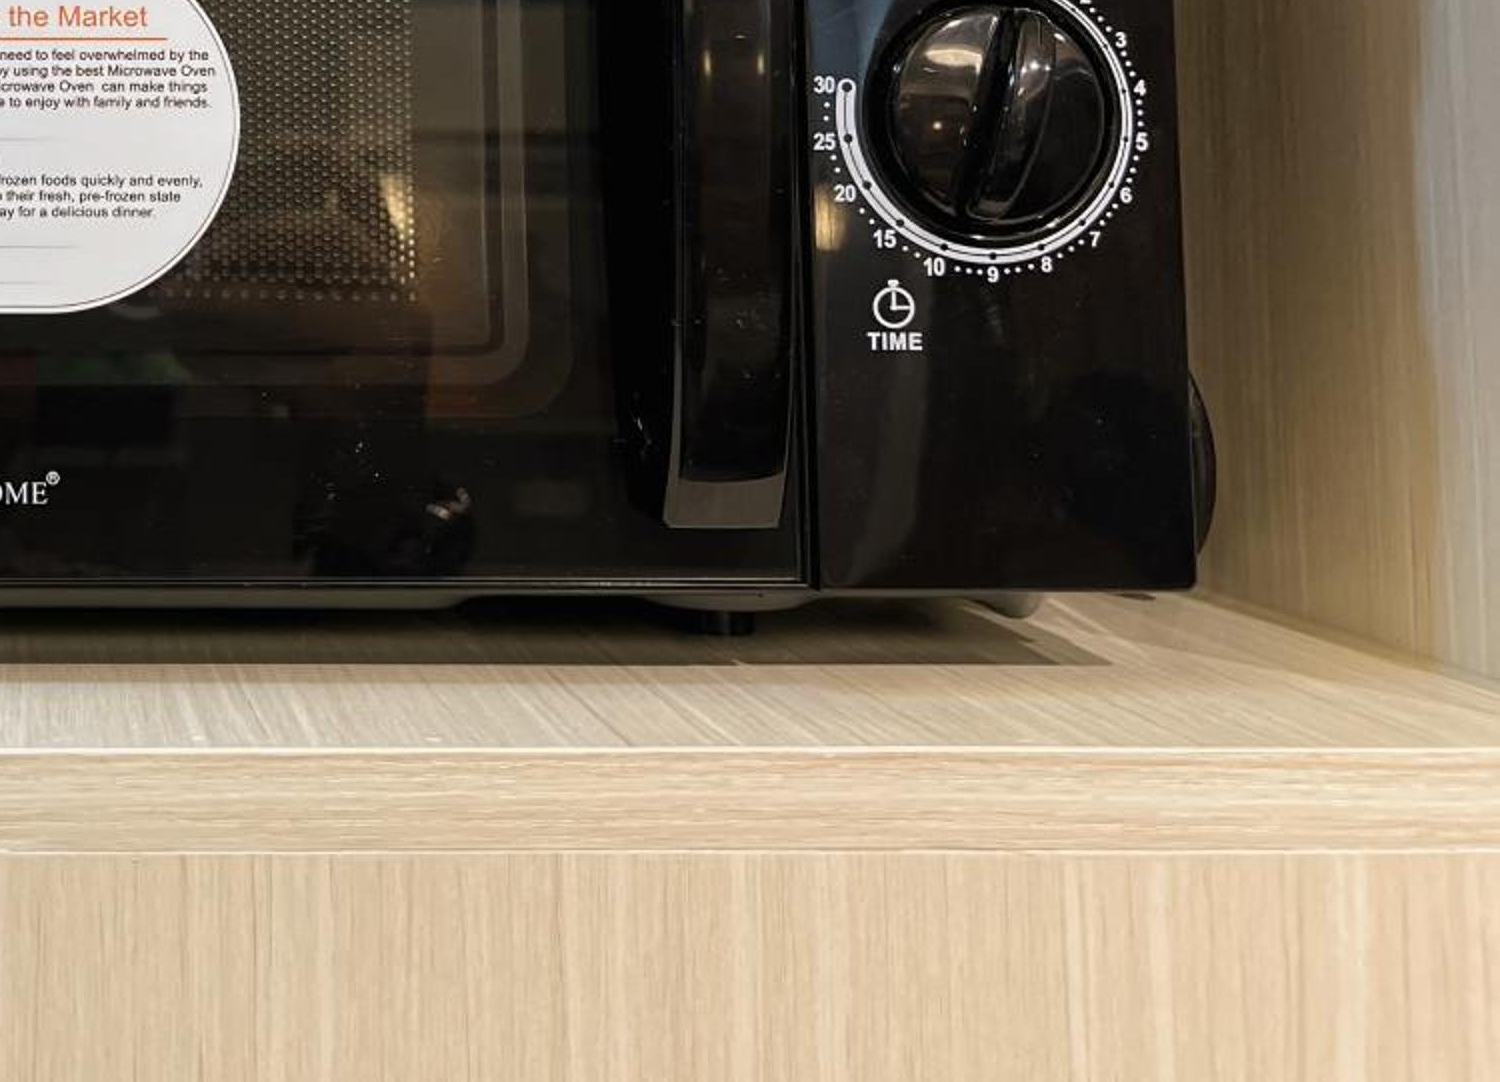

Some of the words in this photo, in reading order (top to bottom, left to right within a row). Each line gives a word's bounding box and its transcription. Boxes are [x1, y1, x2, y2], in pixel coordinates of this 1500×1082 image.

[8, 5, 48, 28] the
[58, 5, 148, 28] Market
[1115, 32, 1127, 48] 3
[0, 49, 32, 60] need
[36, 49, 48, 60] to
[52, 49, 75, 60] feel
[79, 49, 164, 60] overwhelmed
[169, 49, 186, 63] by
[188, 49, 208, 60] the
[14, 65, 48, 79] using
[52, 65, 71, 76] the
[76, 65, 104, 76] best
[108, 65, 176, 76] Microwave
[180, 65, 216, 76] Oven
[59, 81, 94, 92] Oven
[101, 84, 125, 92] can
[129, 81, 164, 92] make
[168, 81, 208, 95] things
[813, 78, 835, 94] 30
[1133, 79, 1146, 96] 4
[8, 97, 22, 108] to
[25, 97, 60, 110] enjoy
[64, 97, 90, 108] with
[94, 97, 132, 110] family
[136, 97, 160, 108] and
[164, 97, 212, 108] friends.
[813, 134, 836, 150] 25
[1135, 133, 1148, 150] 5
[41, 174, 77, 186] foods
[80, 174, 124, 188] quickly
[129, 174, 152, 186] and
[6, 190, 36, 202] their
[39, 190, 75, 204] fresh,
[79, 190, 144, 204] pre-frozen
[150, 190, 180, 202] state
[835, 185, 856, 202] 20
[1120, 187, 1132, 203] 6
[18, 206, 36, 218] for
[39, 209, 48, 218] a
[52, 206, 108, 218] delicious
[874, 231, 896, 248] 15
[1090, 232, 1100, 247] 7
[924, 259, 945, 275] 10
[1041, 257, 1052, 273] 8
[987, 266, 998, 282] 9
[867, 332, 923, 350] TIME
